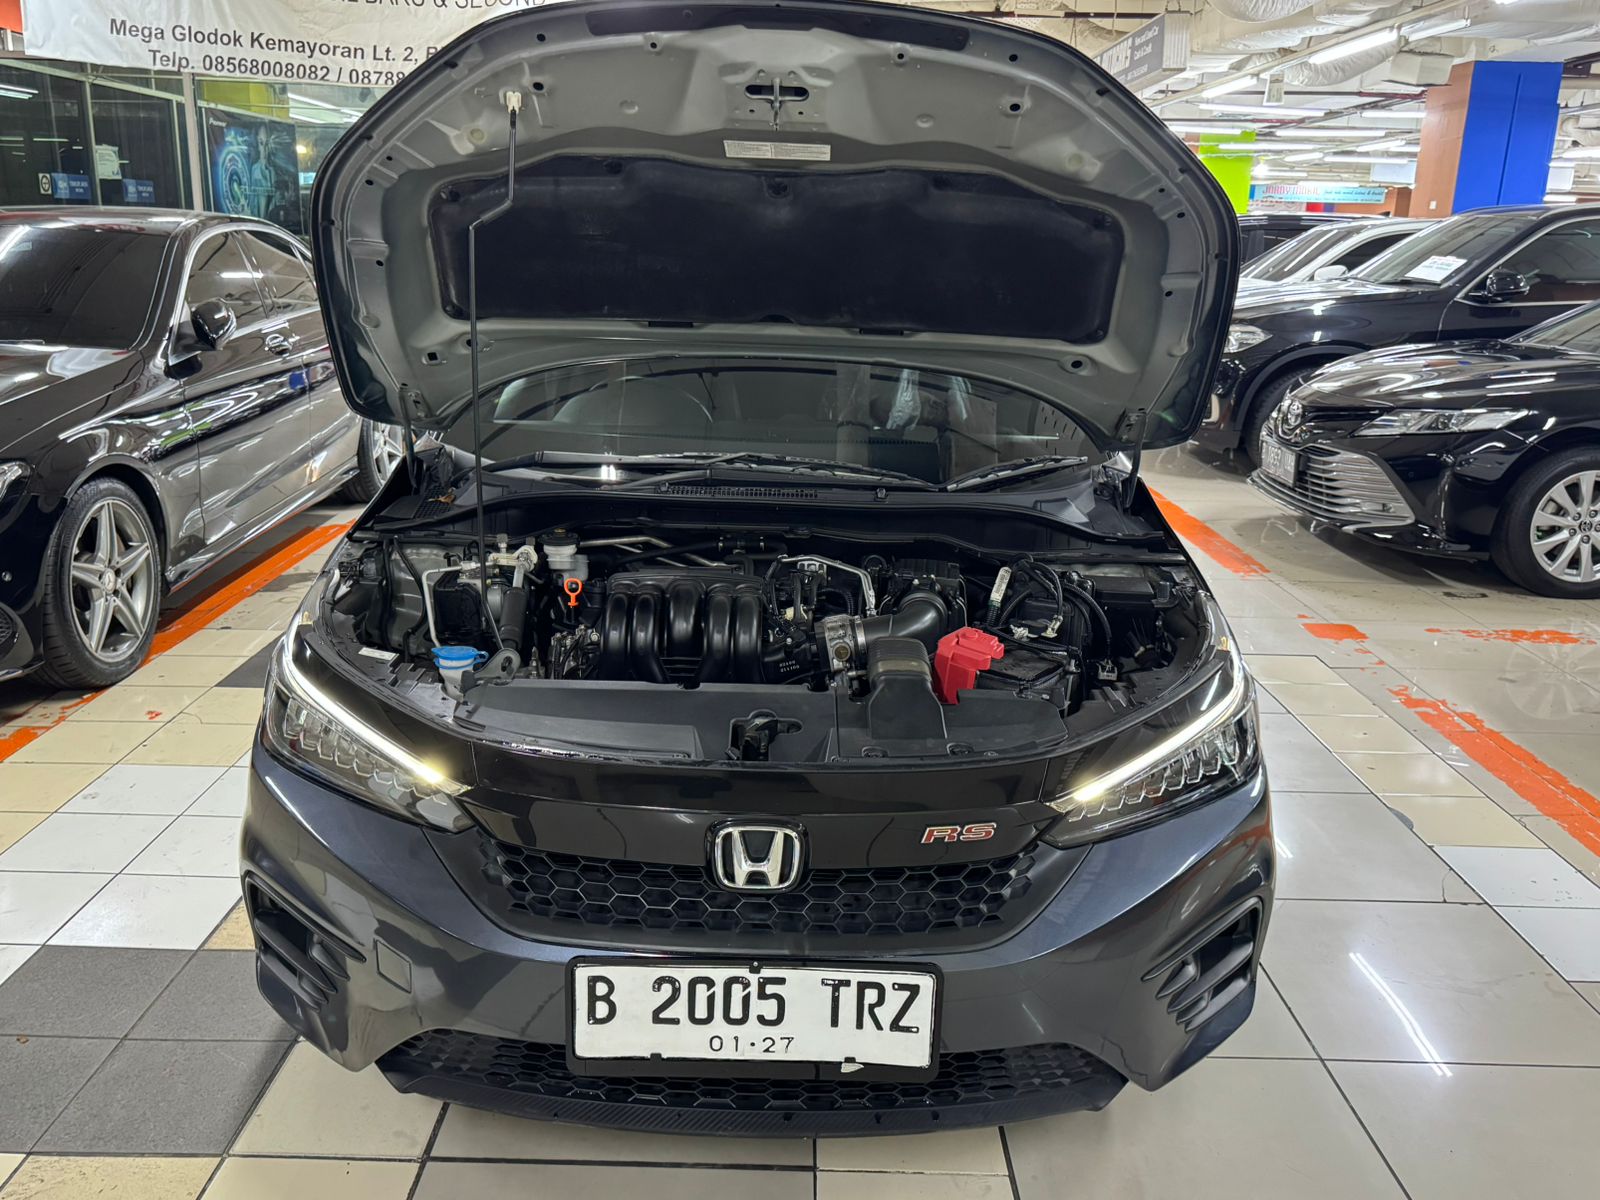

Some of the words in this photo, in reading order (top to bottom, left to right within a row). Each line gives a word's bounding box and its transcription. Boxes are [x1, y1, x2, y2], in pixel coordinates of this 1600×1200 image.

[110, 18, 165, 43] Mega
[172, 24, 244, 47] Glodok
[250, 31, 365, 59] Kemayoran
[373, 45, 396, 62] Lt.
[402, 46, 418, 64] 2,
[148, 49, 195, 72] Telp.
[202, 54, 330, 82] 08568008082
[920, 822, 997, 844] RS
[587, 975, 617, 1026] B
[651, 976, 787, 1027] 2005
[820, 978, 921, 1034] TRZ
